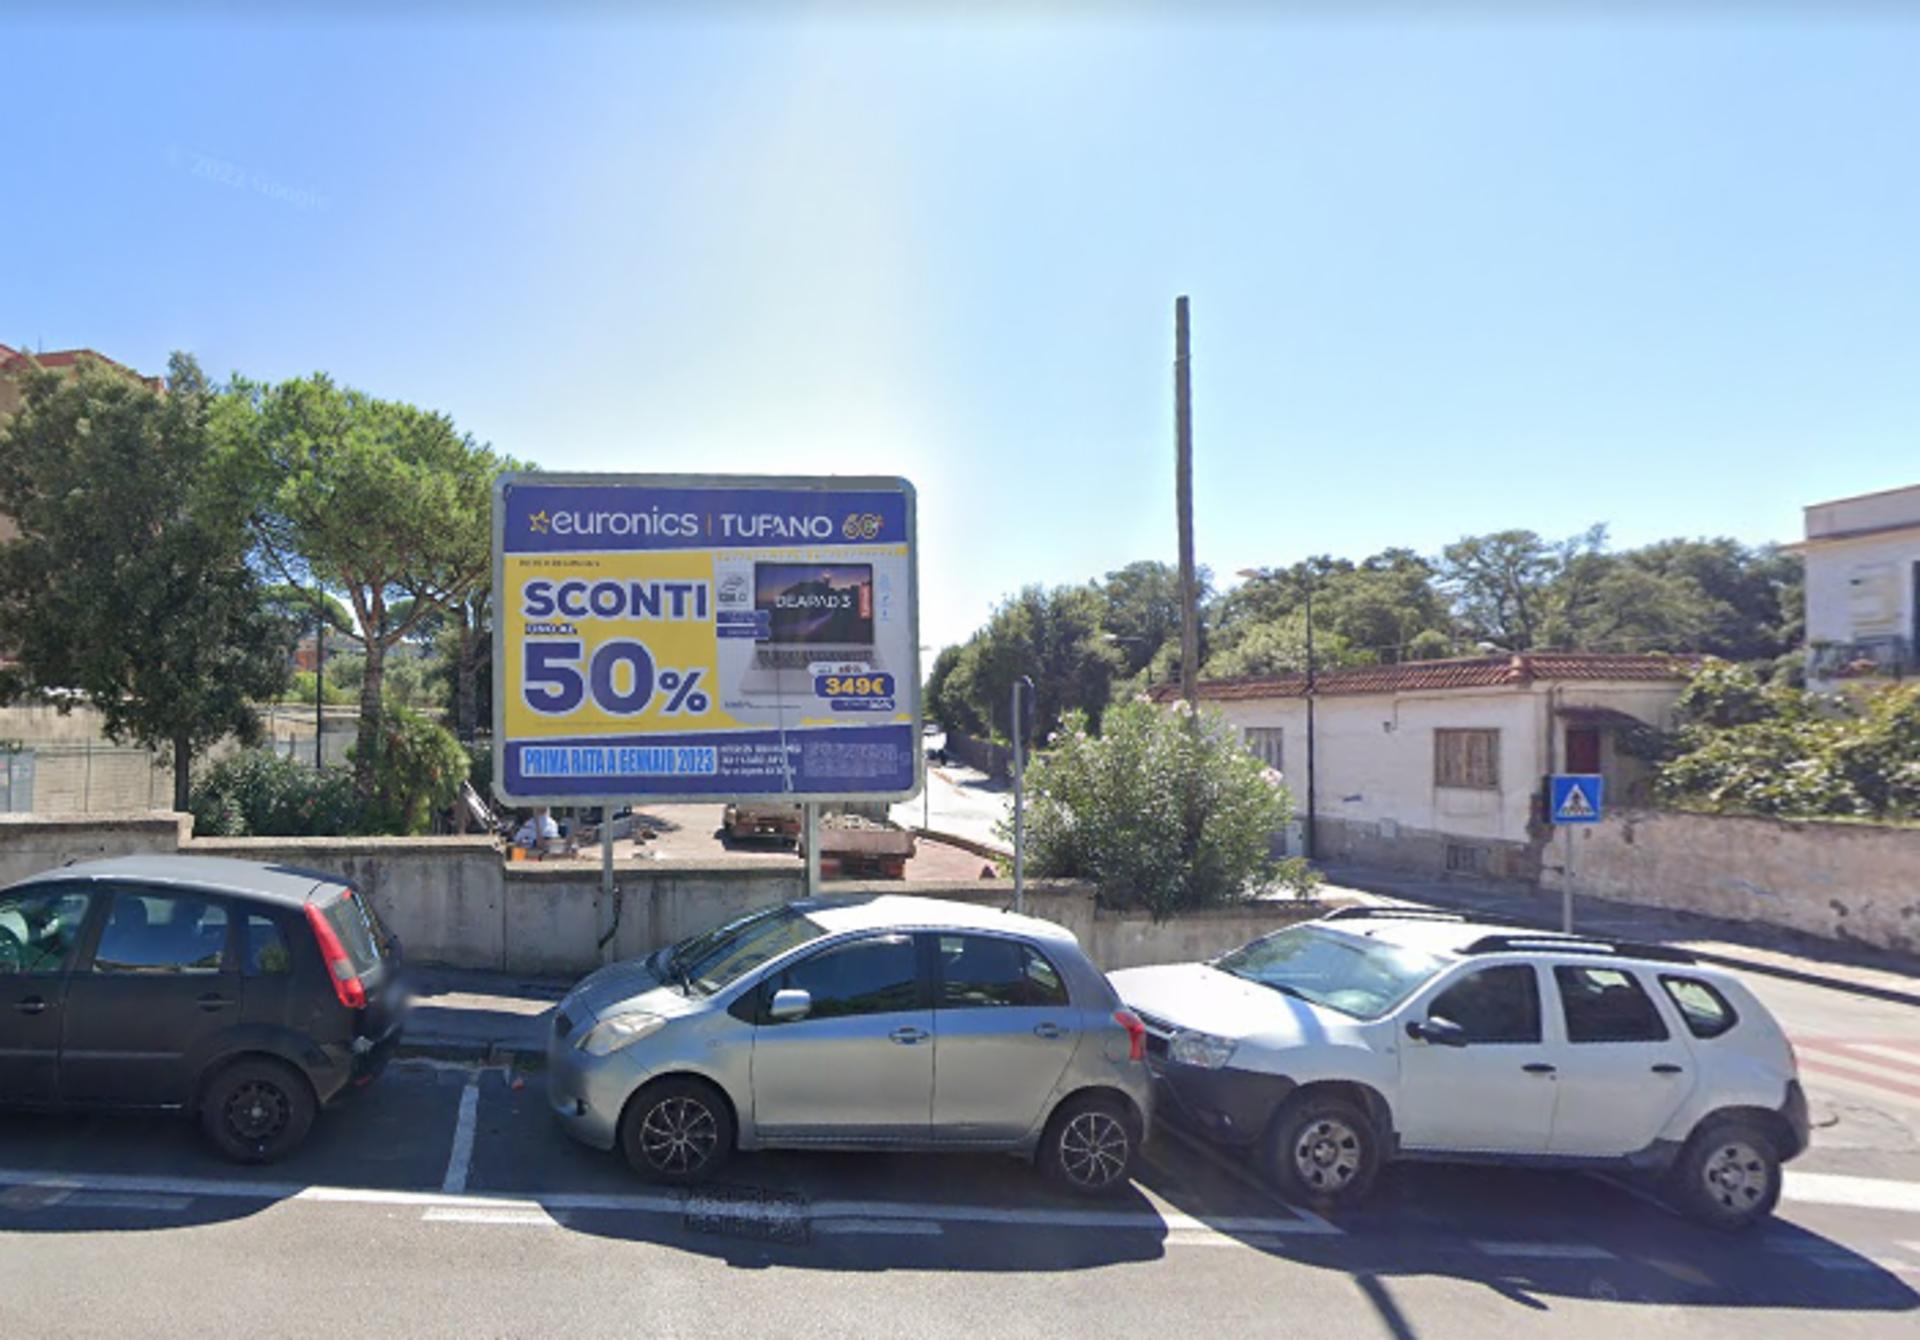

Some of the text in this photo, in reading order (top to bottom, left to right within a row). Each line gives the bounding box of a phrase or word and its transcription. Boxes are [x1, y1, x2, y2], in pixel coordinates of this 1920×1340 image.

[551, 506, 699, 535] euronics
[719, 514, 833, 538] TUFANO
[524, 581, 708, 617] SCONTI
[524, 641, 709, 715] 50%
[825, 677, 885, 696] 349€
[524, 747, 714, 774] PRIMA RATA A GENNAIO 2023
